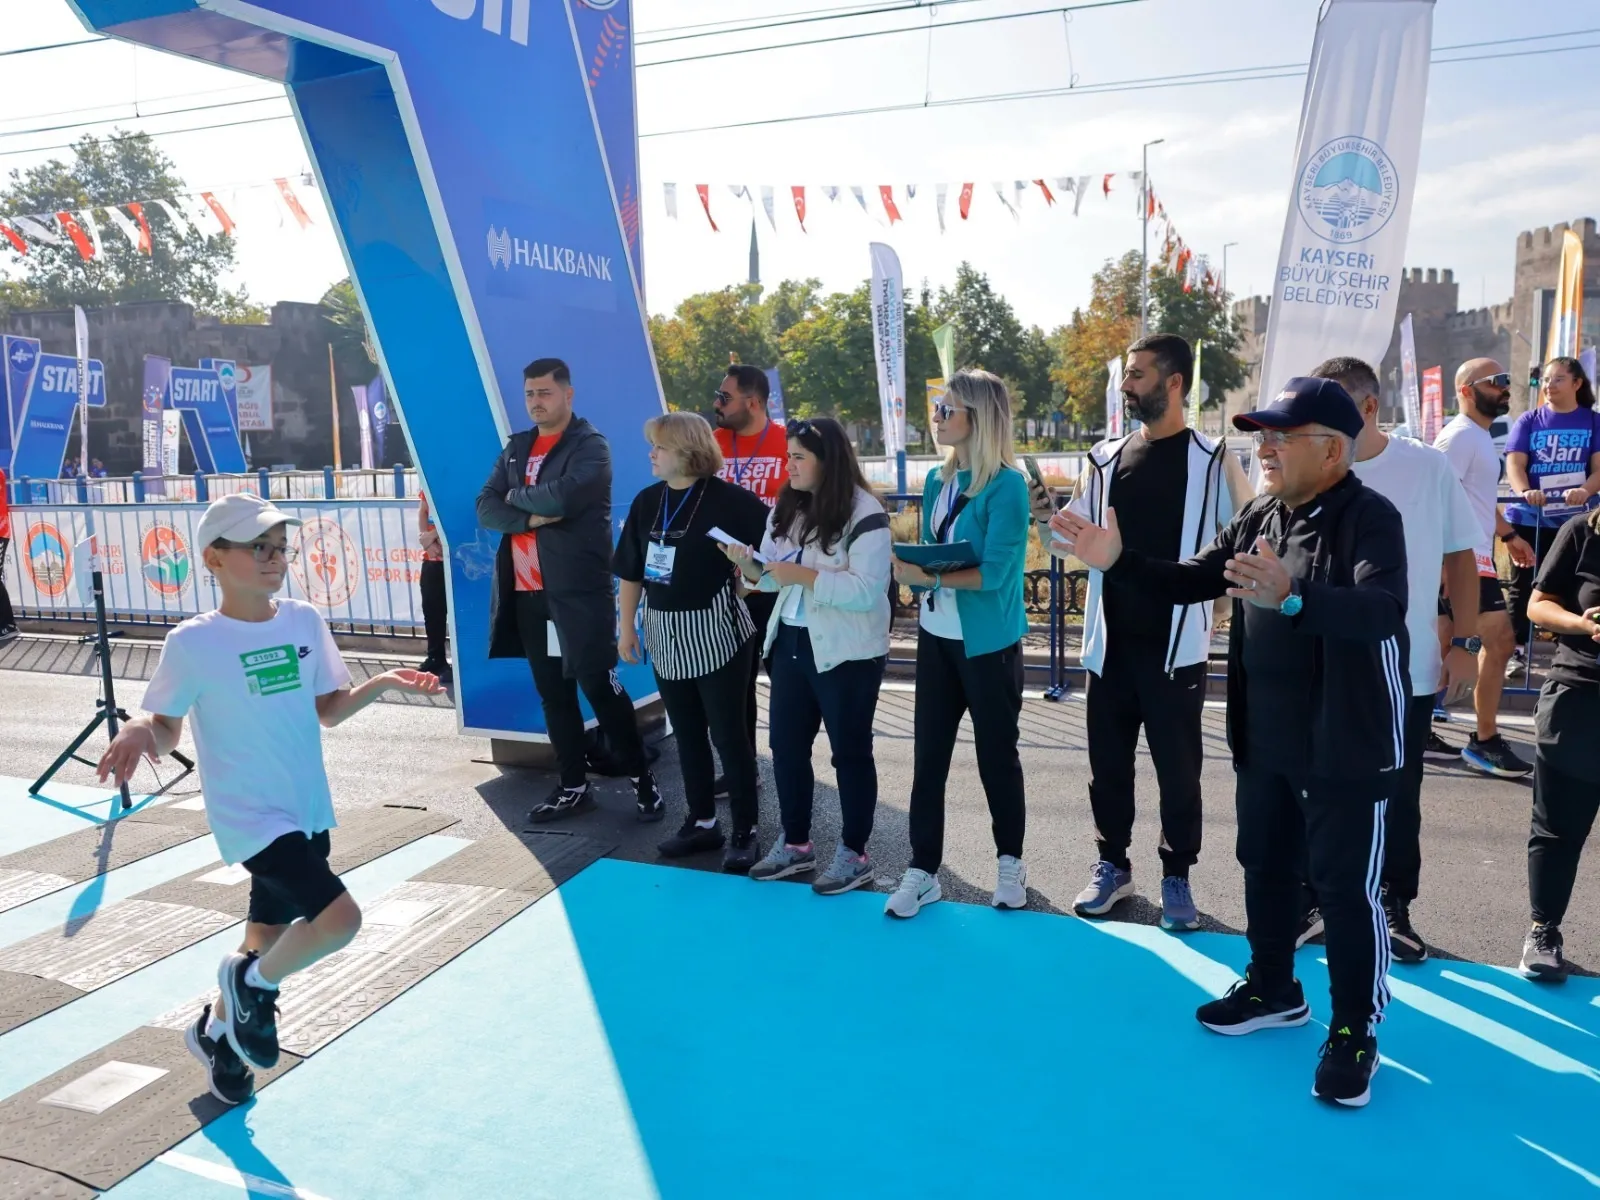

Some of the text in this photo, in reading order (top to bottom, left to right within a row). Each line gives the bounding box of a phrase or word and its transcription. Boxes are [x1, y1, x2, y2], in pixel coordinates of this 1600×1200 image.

[1330, 229, 1352, 239] 1869
[513, 237, 612, 281] HALKBANK
[42, 365, 102, 395] STAT
[174, 378, 219, 402] START
[714, 457, 782, 481] ayseri
[253, 651, 279, 662] 21092
